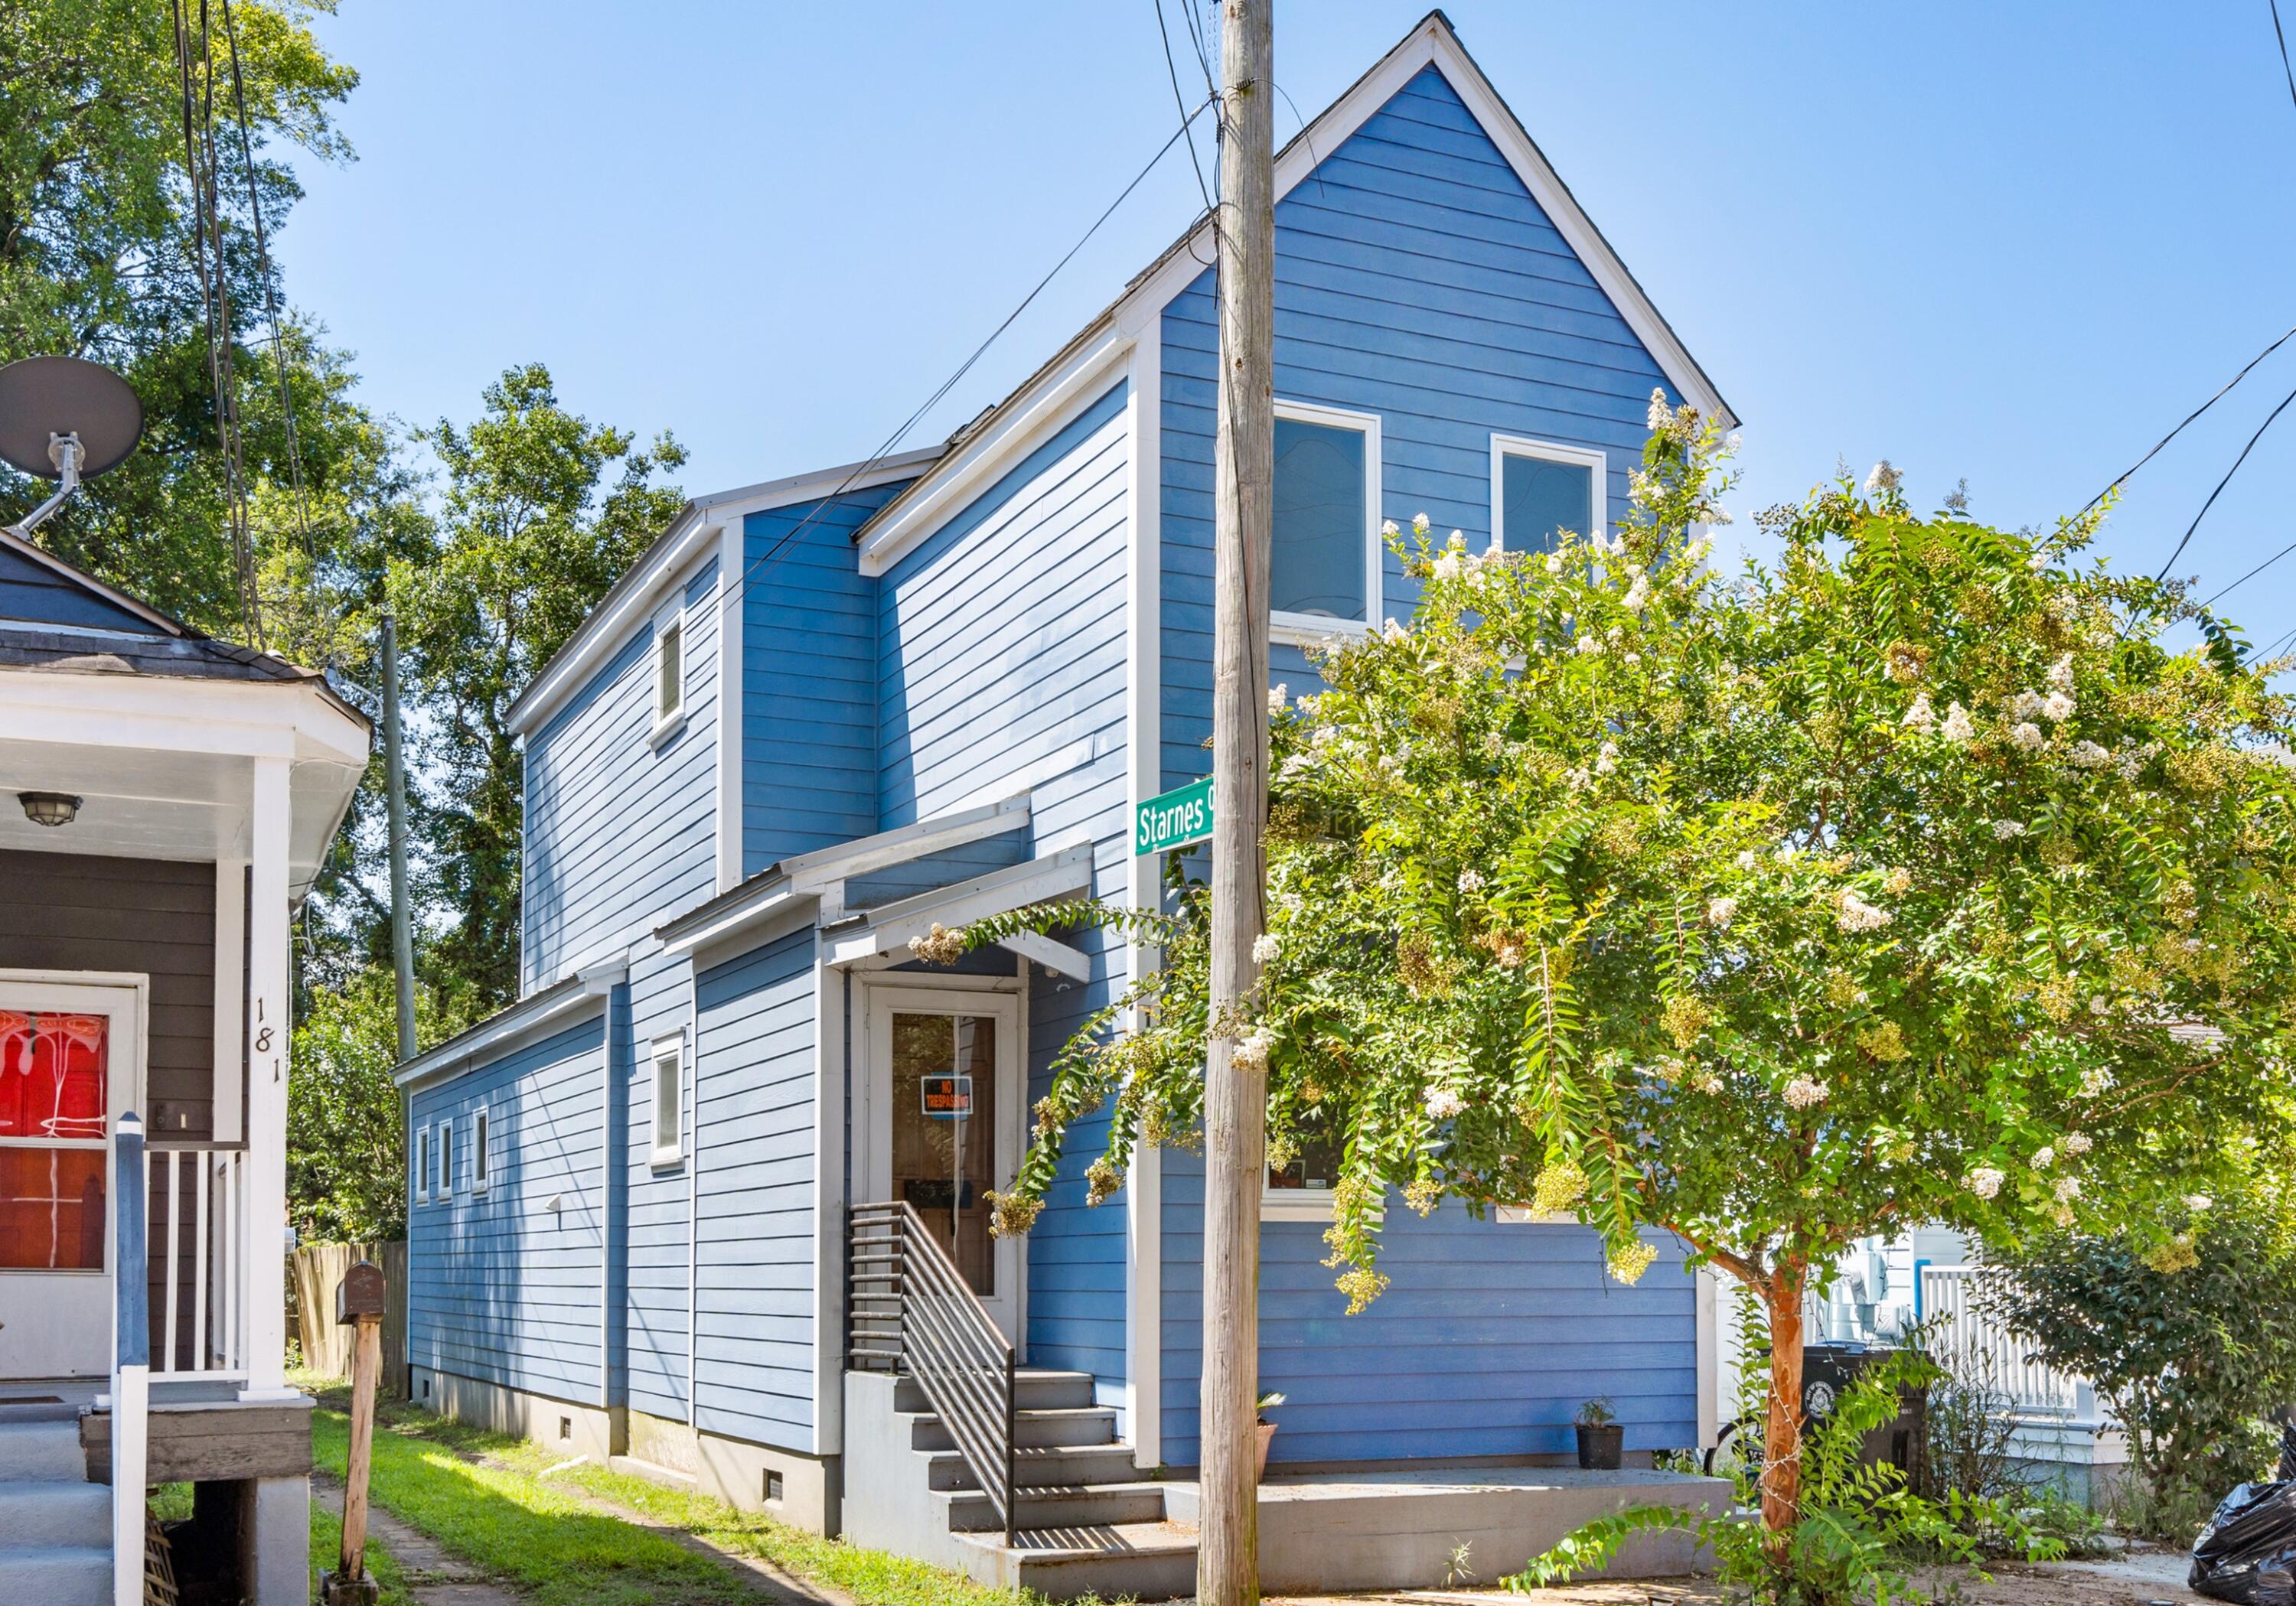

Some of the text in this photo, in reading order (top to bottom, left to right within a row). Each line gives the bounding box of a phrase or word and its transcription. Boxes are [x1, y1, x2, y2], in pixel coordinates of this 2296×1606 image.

[1140, 798, 1203, 846] Starnes
[942, 1080, 952, 1093] NO
[926, 1094, 968, 1108] TRESPASSING
